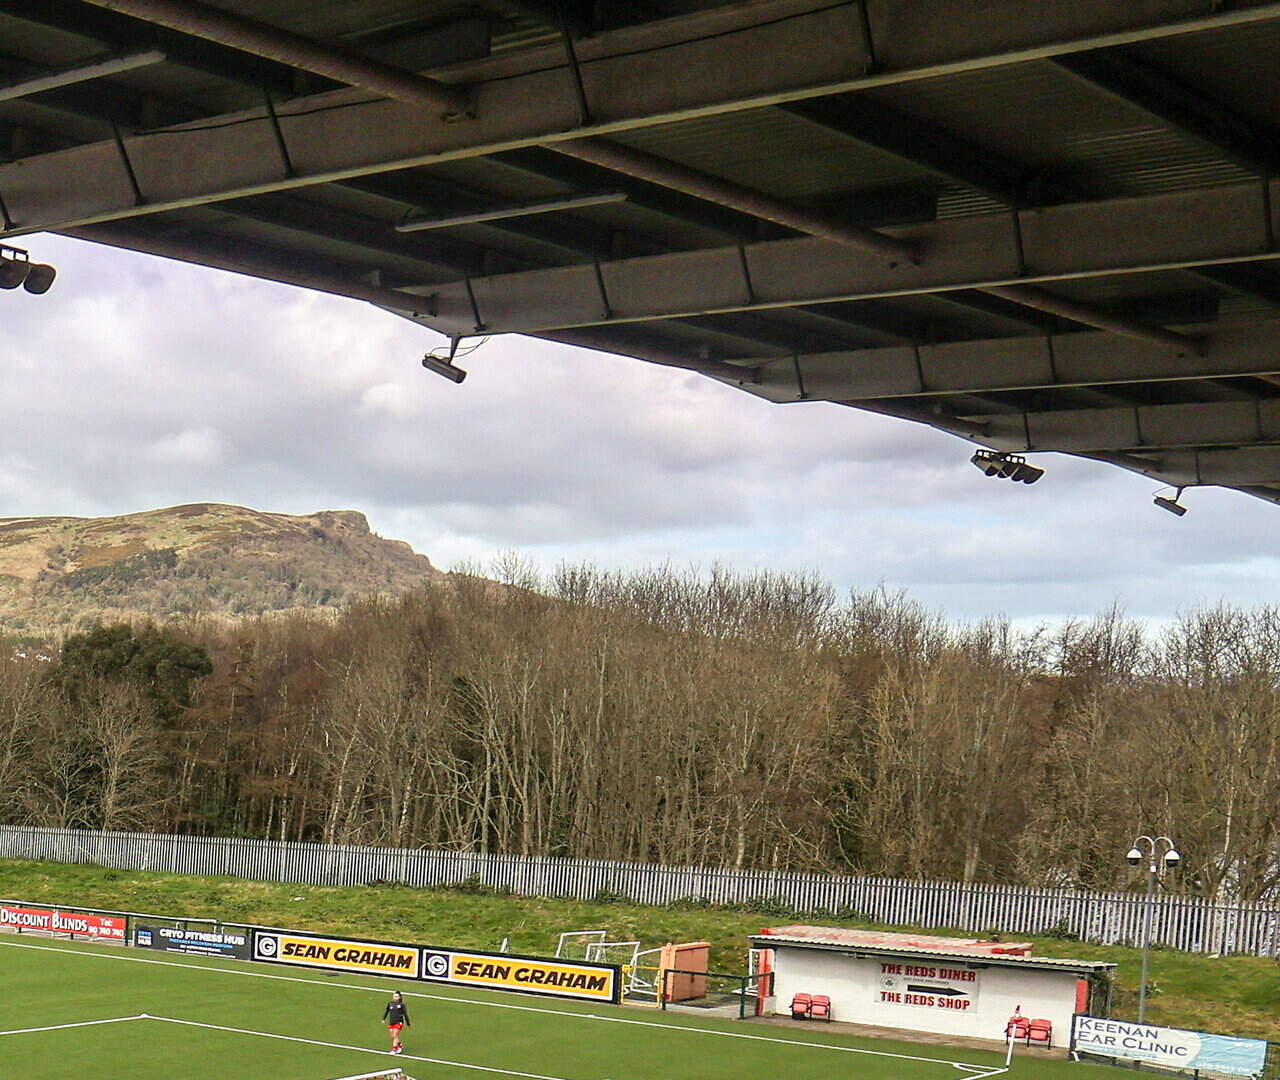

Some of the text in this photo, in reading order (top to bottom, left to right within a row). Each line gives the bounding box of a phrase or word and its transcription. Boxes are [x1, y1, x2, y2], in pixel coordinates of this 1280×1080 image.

[160, 928, 245, 945] CRYO FITNESS HUB
[282, 942, 331, 960] SEAN
[333, 948, 413, 969] GRAHAM
[455, 961, 510, 980] SEAN
[514, 967, 608, 991] GRAHAM
[880, 963, 976, 982] THE REDS DINER
[880, 991, 970, 1010] THE REDS SHOP
[1079, 1018, 1159, 1039] KEENAN
[1078, 1030, 1121, 1046] EAR
[1122, 1037, 1189, 1056] CLINIC
